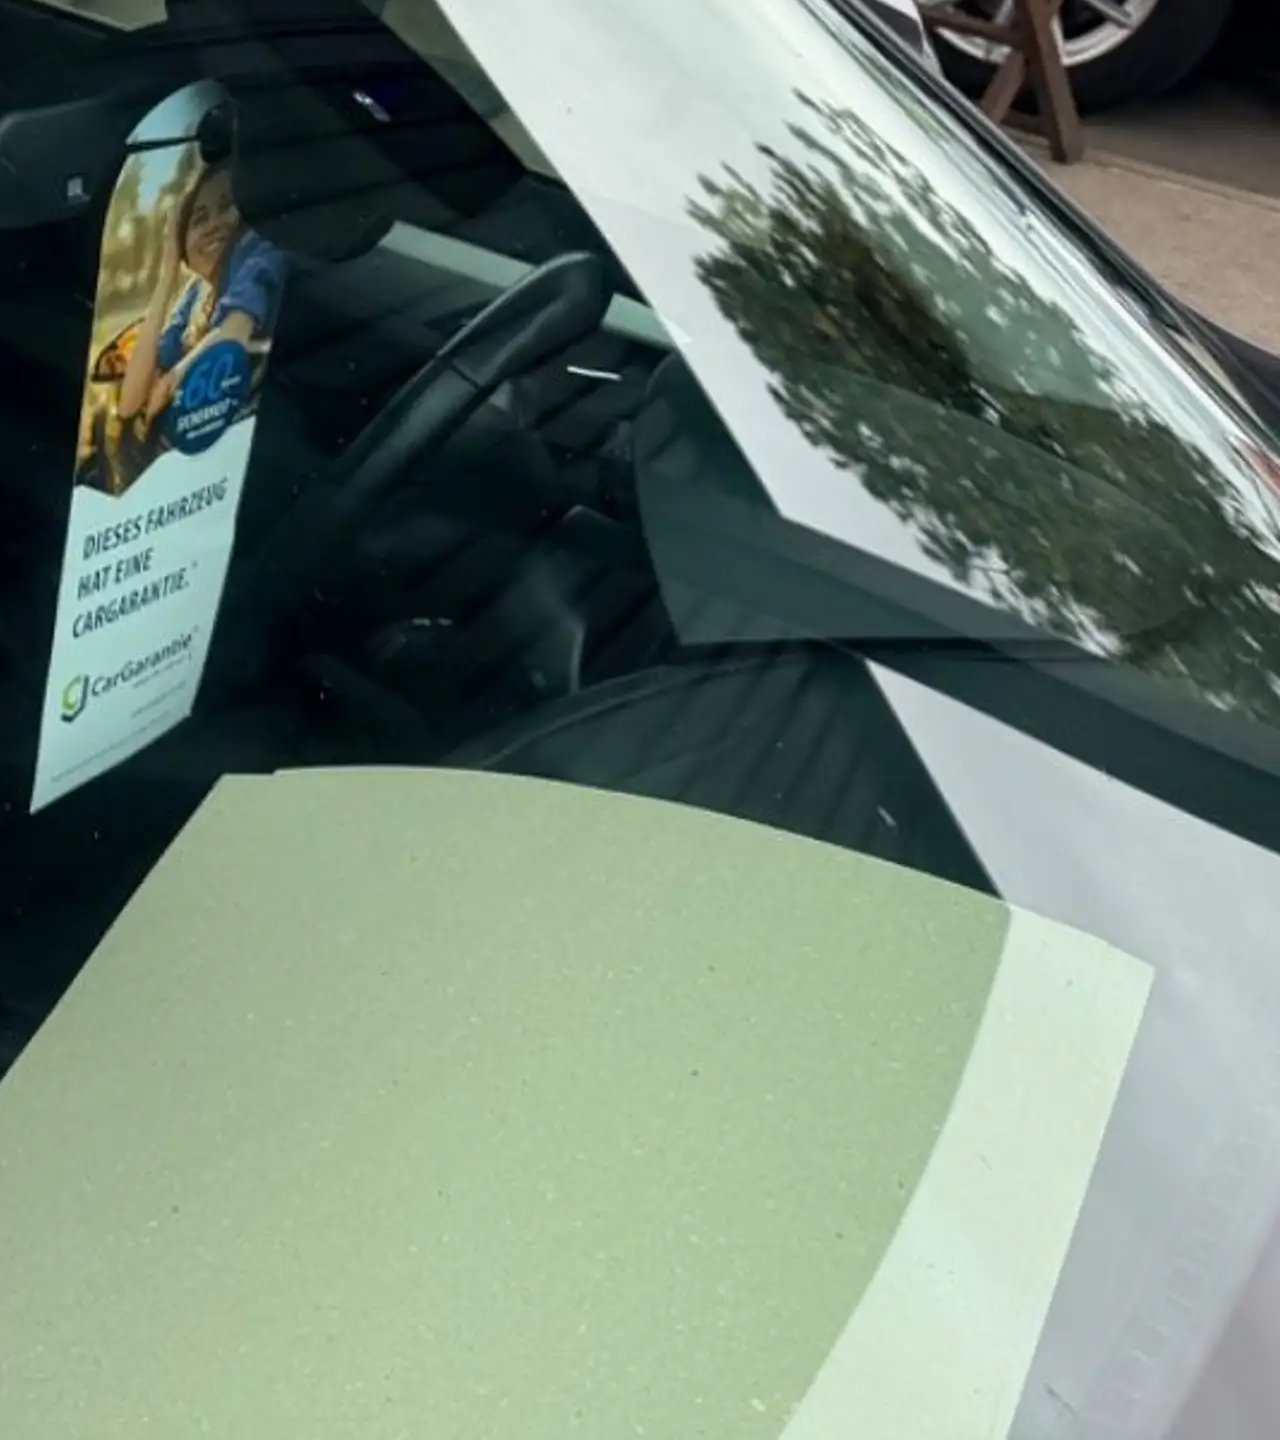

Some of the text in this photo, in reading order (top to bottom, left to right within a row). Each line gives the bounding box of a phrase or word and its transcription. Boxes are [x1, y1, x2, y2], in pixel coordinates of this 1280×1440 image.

[83, 476, 228, 560] DIESES FAHRZEUG
[77, 547, 154, 601] HAT EINE
